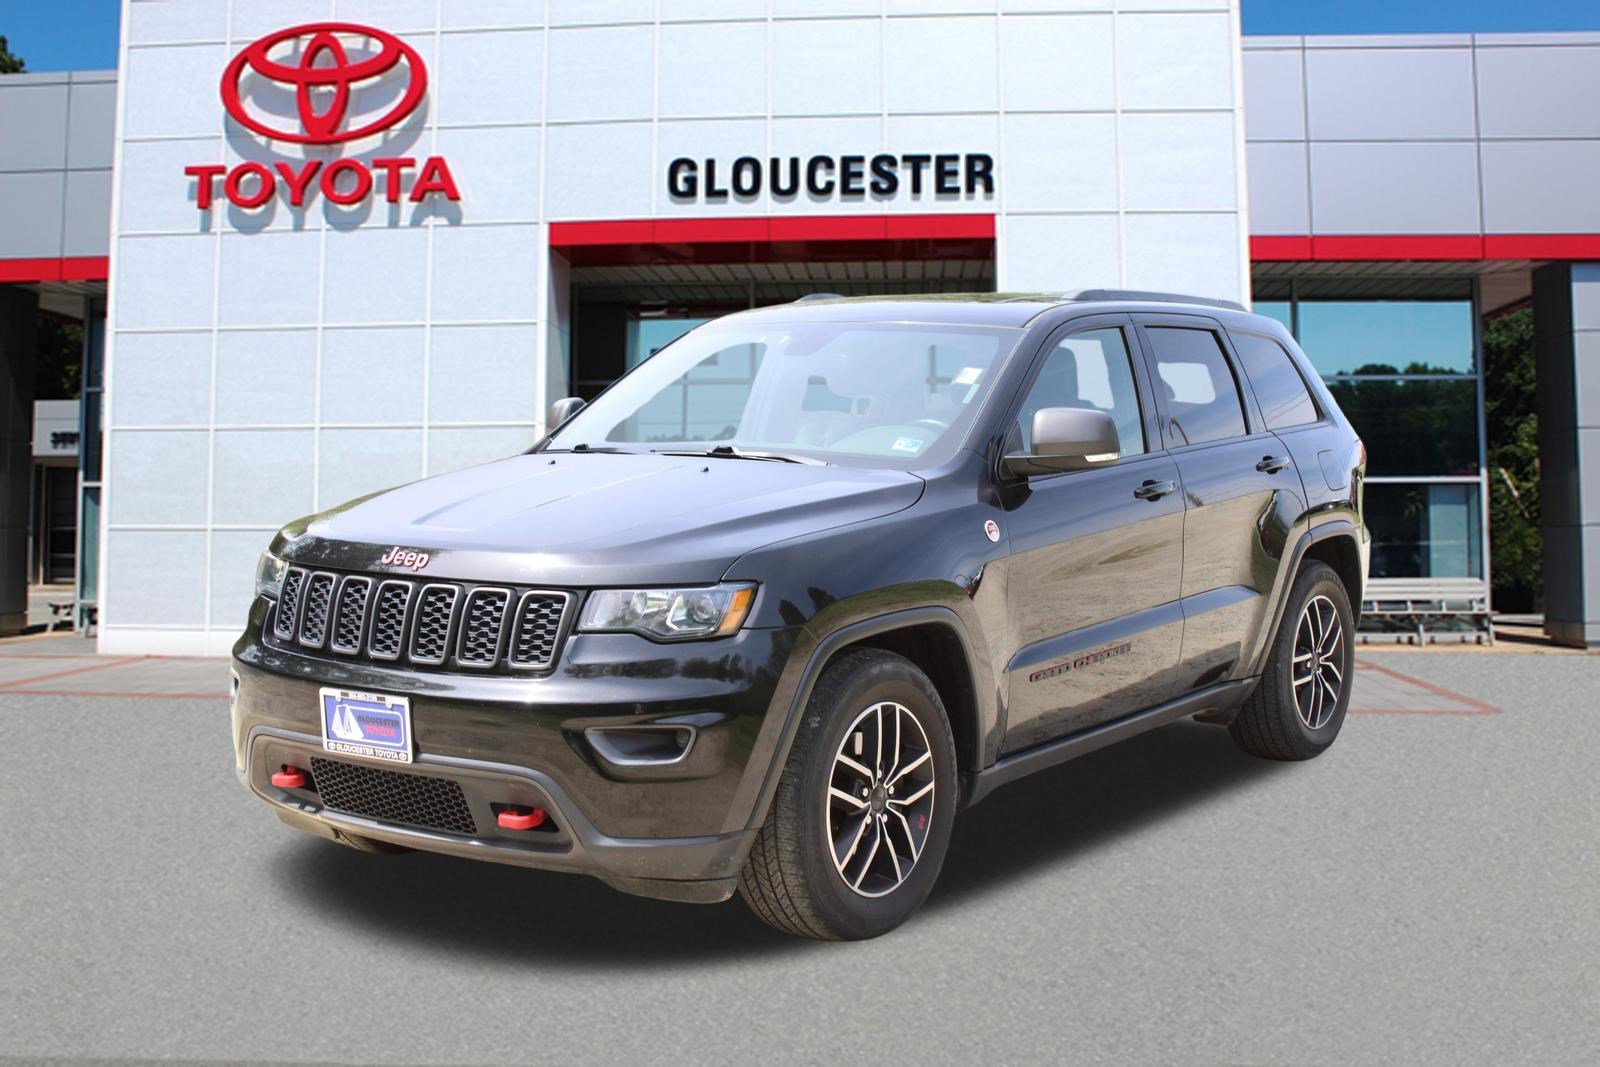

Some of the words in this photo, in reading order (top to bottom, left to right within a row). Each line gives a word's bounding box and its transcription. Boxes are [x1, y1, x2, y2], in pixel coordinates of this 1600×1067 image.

[185, 156, 461, 209] TOYOTA
[667, 153, 994, 200] GLOUCESTER
[380, 546, 430, 572] Jeep
[336, 743, 374, 756] GLOUCESTER
[374, 749, 399, 760] TOYOTA
